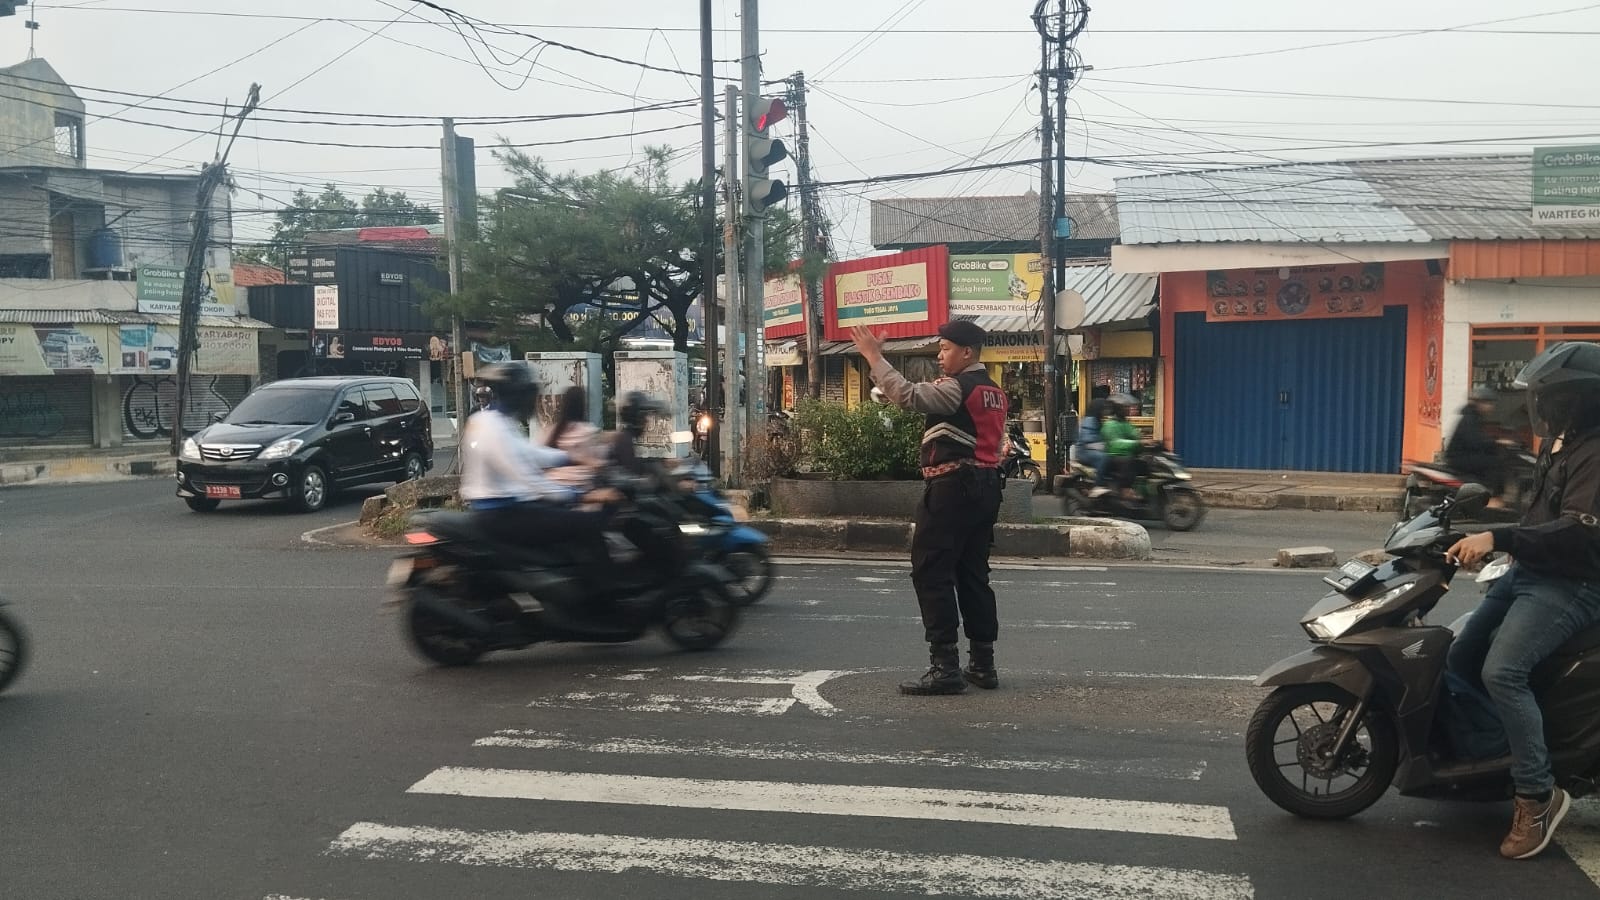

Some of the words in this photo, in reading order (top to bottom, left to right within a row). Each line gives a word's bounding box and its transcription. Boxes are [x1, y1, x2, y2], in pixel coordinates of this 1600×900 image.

[1538, 209, 1586, 220] WARTEG
[952, 260, 987, 270] GrabBike
[143, 269, 178, 279] GrabBike
[948, 303, 976, 312] WARUNG
[976, 303, 1006, 312] SEMBAKO
